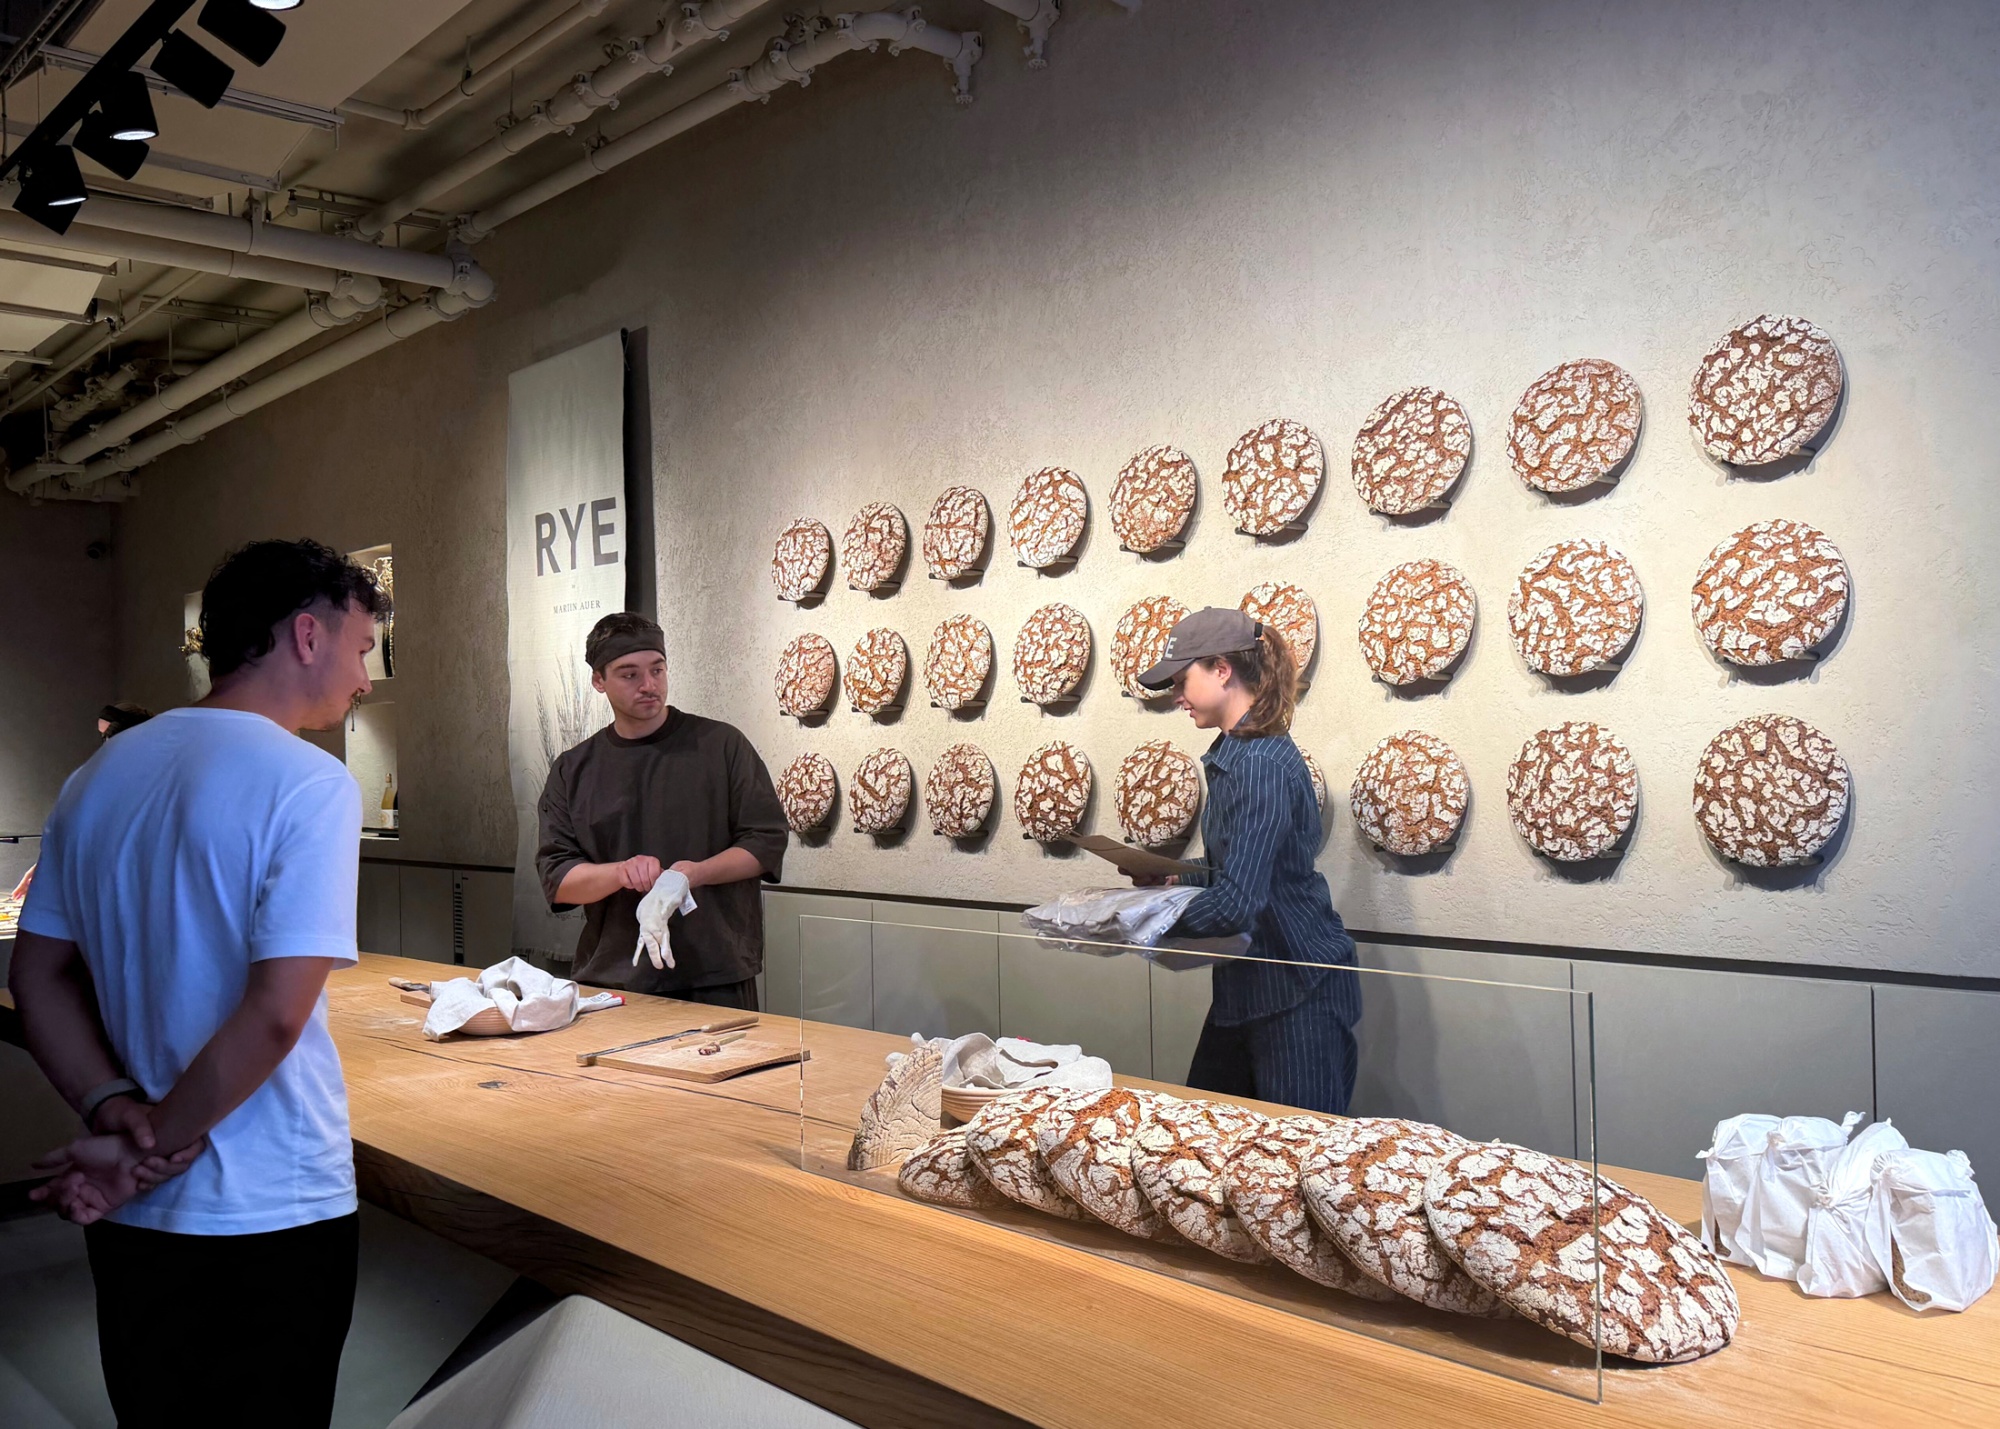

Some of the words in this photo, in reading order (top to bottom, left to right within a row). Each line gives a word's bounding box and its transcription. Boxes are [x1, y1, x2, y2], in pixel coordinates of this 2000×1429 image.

[535, 497, 619, 577] RYE
[553, 602, 577, 614] MARTIN
[580, 600, 601, 611] AUER
